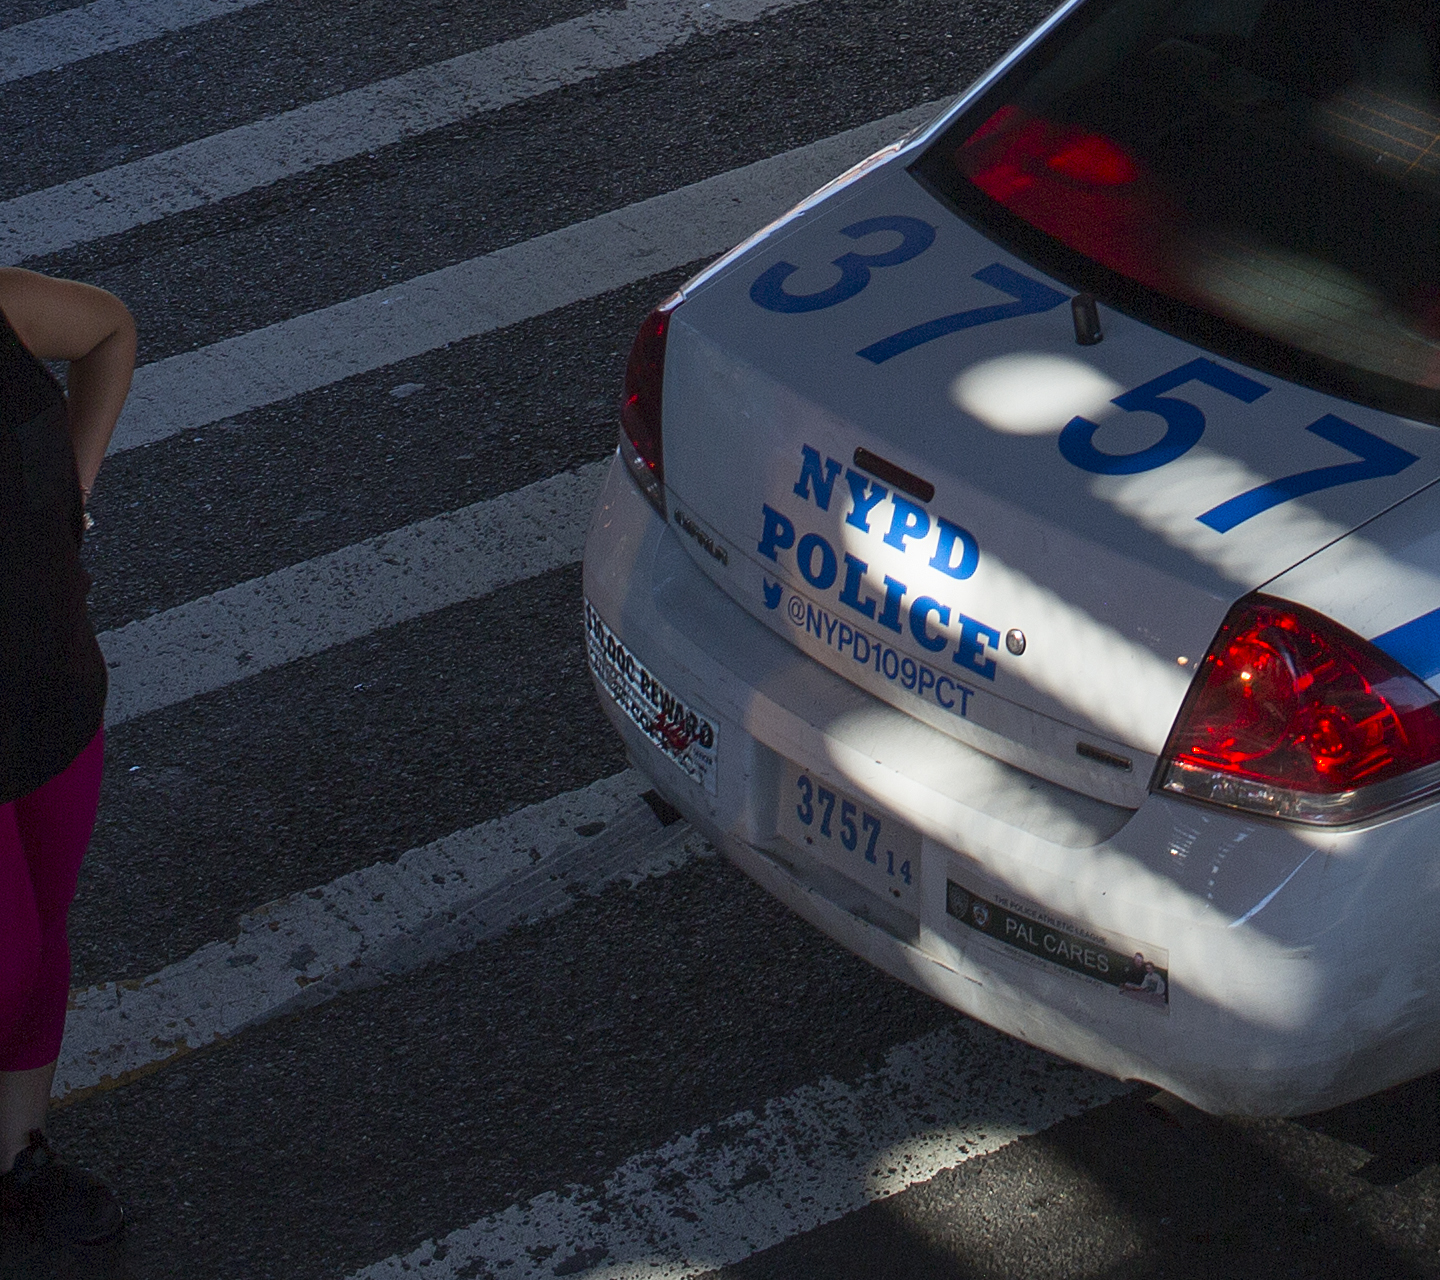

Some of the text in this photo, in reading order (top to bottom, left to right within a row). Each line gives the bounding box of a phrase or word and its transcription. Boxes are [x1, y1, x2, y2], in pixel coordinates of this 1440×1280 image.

[748, 215, 1422, 534] 3757
[792, 442, 980, 581] NYPD
[756, 502, 1002, 682] POLICE
[640, 666, 714, 750] REWARD
[786, 594, 976, 718] @NYPD109PCT
[795, 773, 913, 886] 3757 14
[1004, 917, 1040, 947] PAL
[1042, 932, 1110, 974] CARES
